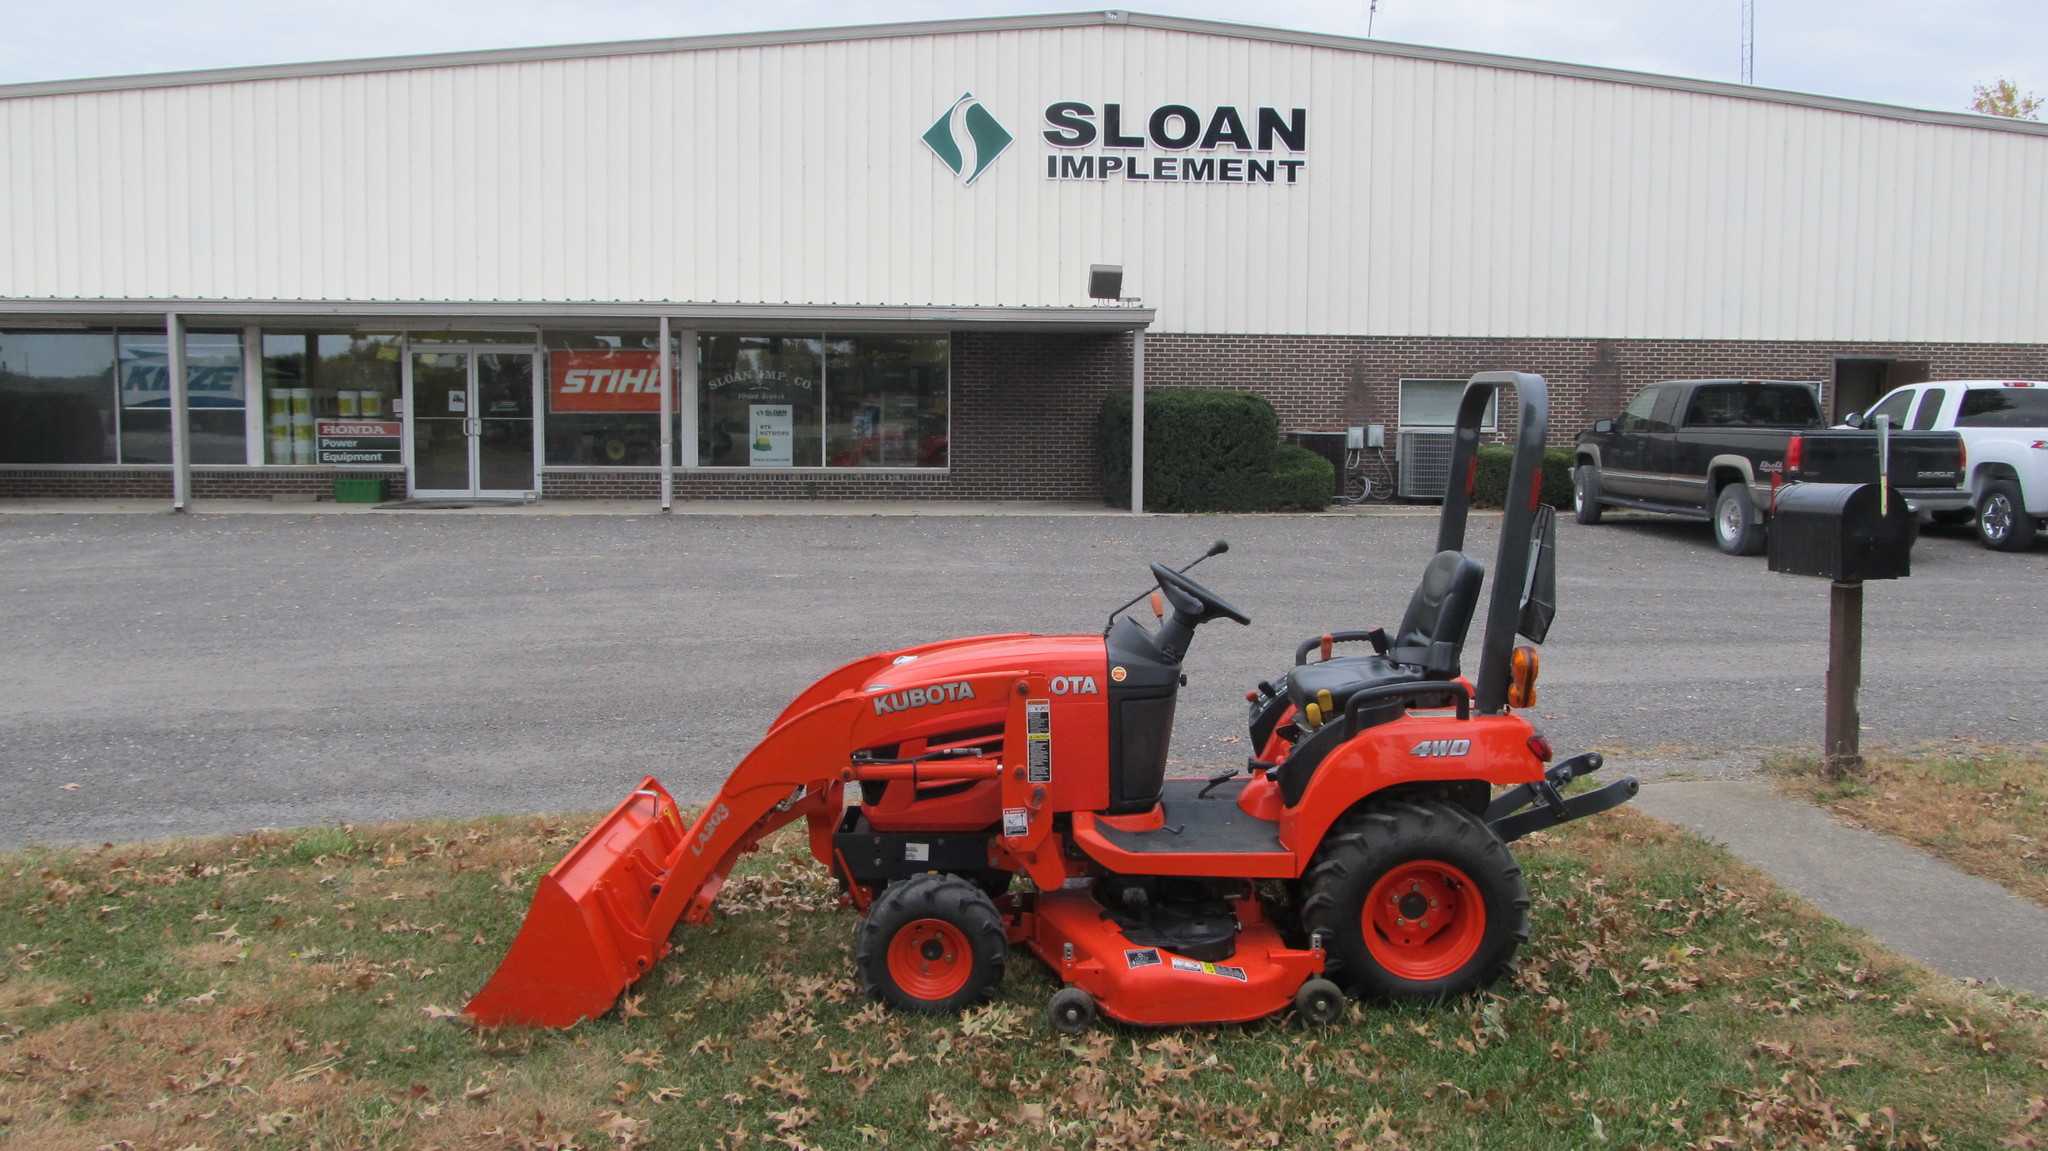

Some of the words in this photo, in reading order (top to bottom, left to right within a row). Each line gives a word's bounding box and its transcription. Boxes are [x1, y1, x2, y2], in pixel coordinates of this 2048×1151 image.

[1042, 101, 1306, 153] SLOAN
[1046, 154, 1306, 184] IMPLEMENT
[560, 368, 661, 394] STIHL
[708, 371, 752, 390] SLOAN
[322, 425, 386, 434] HONDA
[322, 438, 358, 448] Power
[323, 452, 383, 463] Equipment
[1050, 675, 1099, 695] OTA
[872, 680, 976, 716] KUBOTA
[1409, 739, 1471, 757] 4WD
[691, 803, 729, 857] LA203
